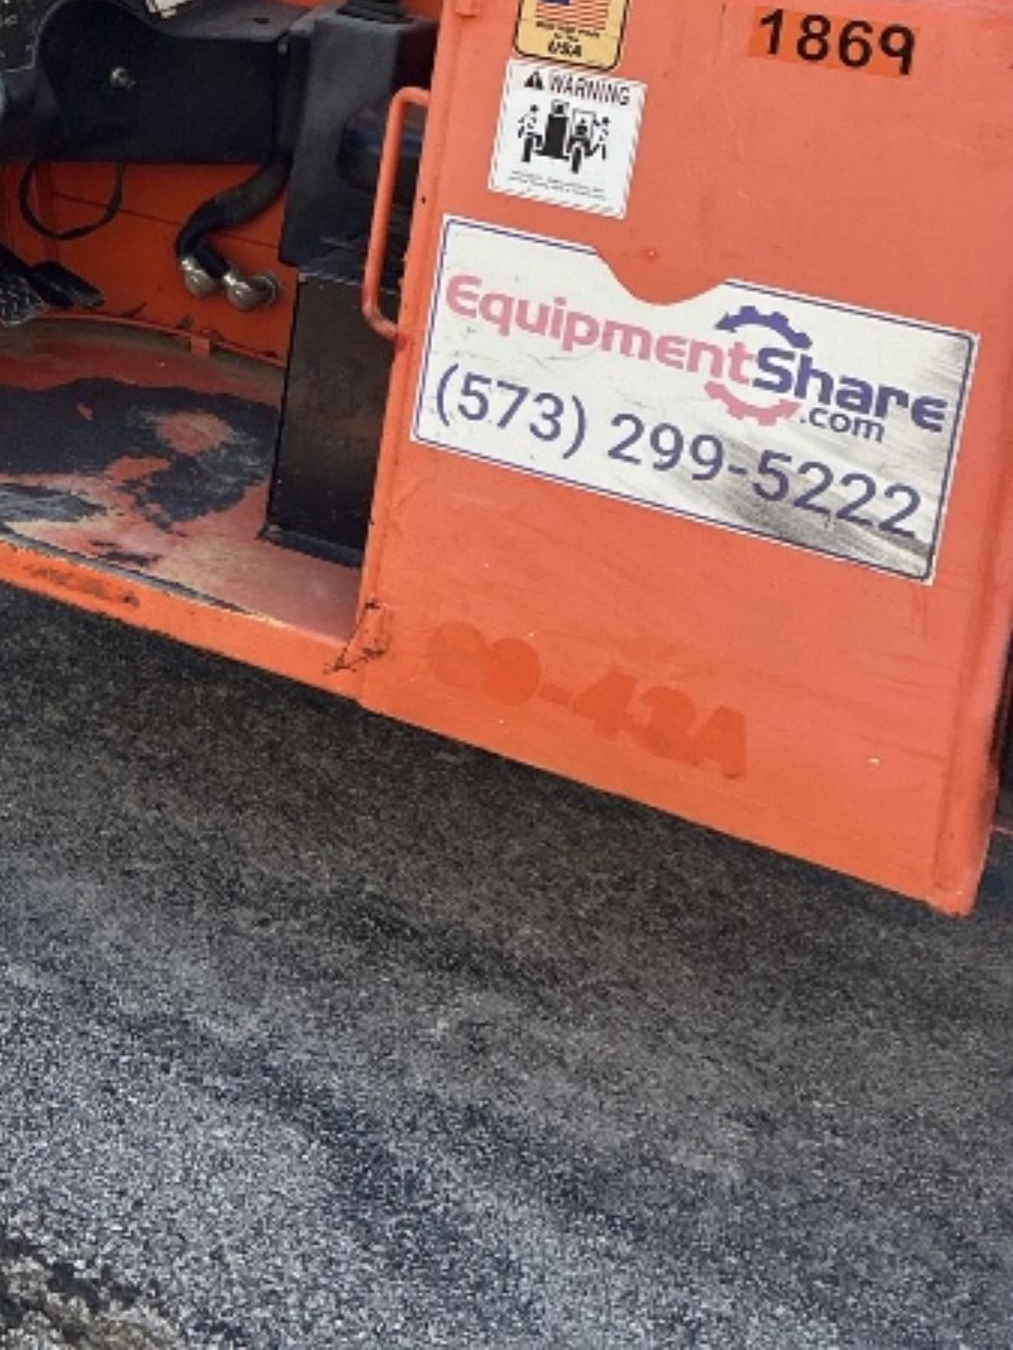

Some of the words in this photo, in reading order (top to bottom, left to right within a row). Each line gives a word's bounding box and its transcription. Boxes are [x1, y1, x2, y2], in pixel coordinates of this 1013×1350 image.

[548, 39, 582, 58] USA
[759, 7, 916, 75] 1869
[549, 74, 631, 106] WARNING
[445, 273, 949, 435] EquipmentShare
[436, 363, 588, 459] (573)
[607, 413, 923, 538] 299-5222
[799, 407, 885, 444] .com
